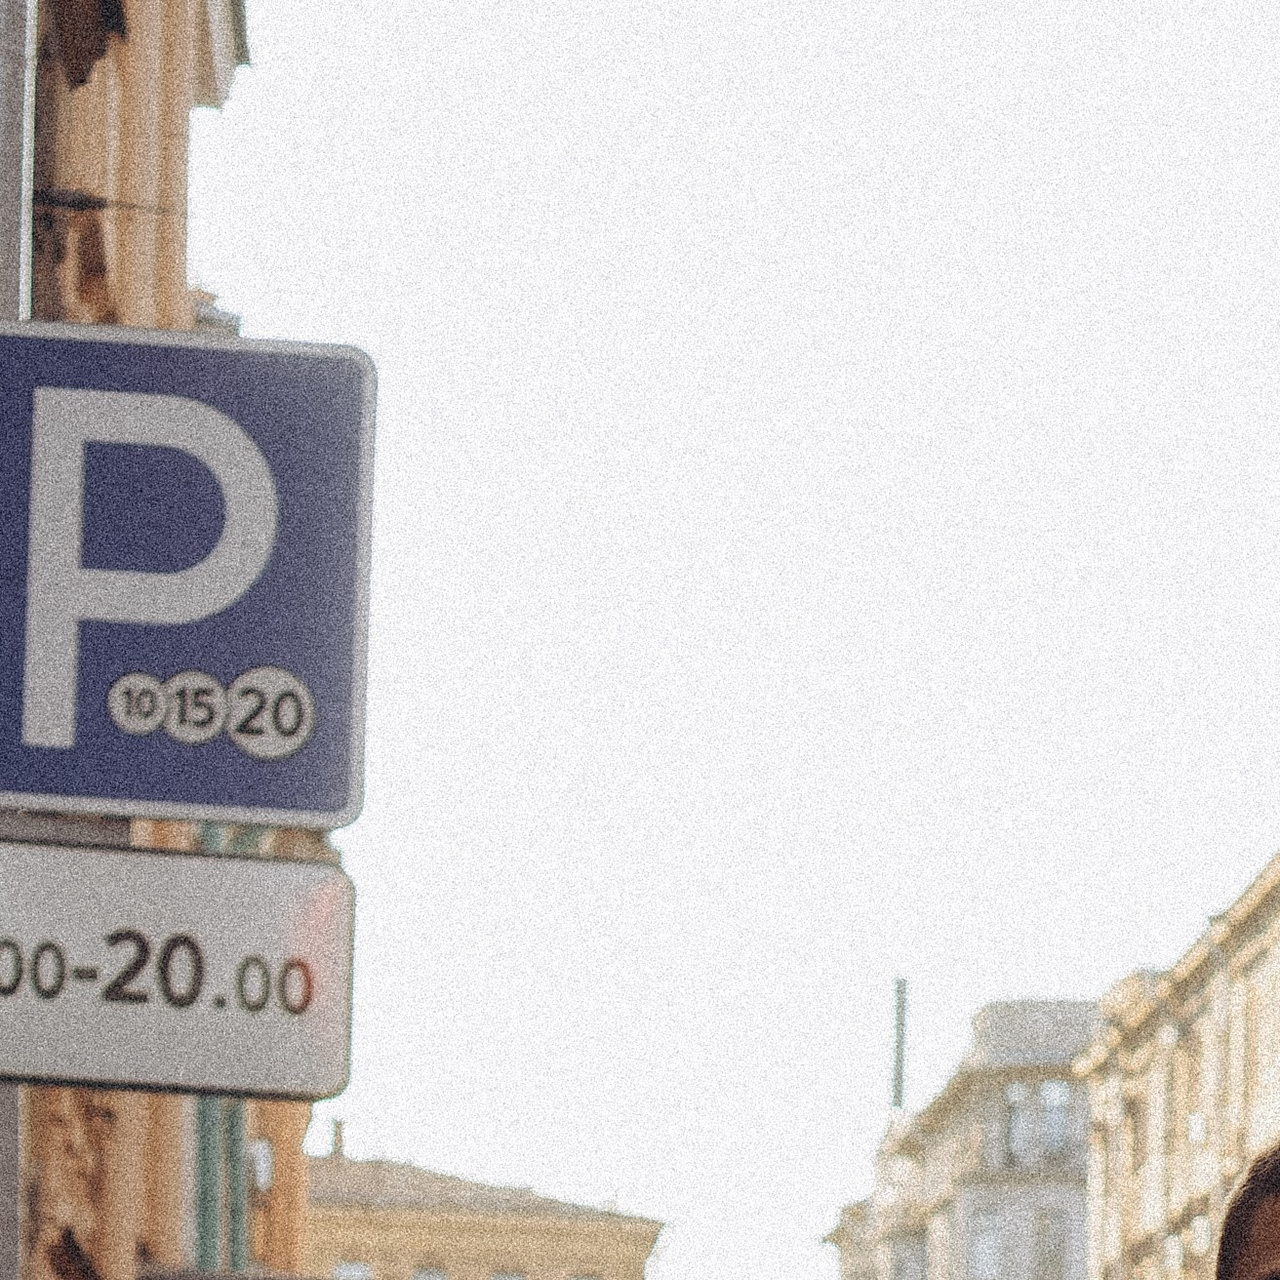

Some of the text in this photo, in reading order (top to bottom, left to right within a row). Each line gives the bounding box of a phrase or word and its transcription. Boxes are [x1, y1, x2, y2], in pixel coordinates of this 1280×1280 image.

[22, 386, 279, 750] P
[121, 686, 304, 737] 10 15 20
